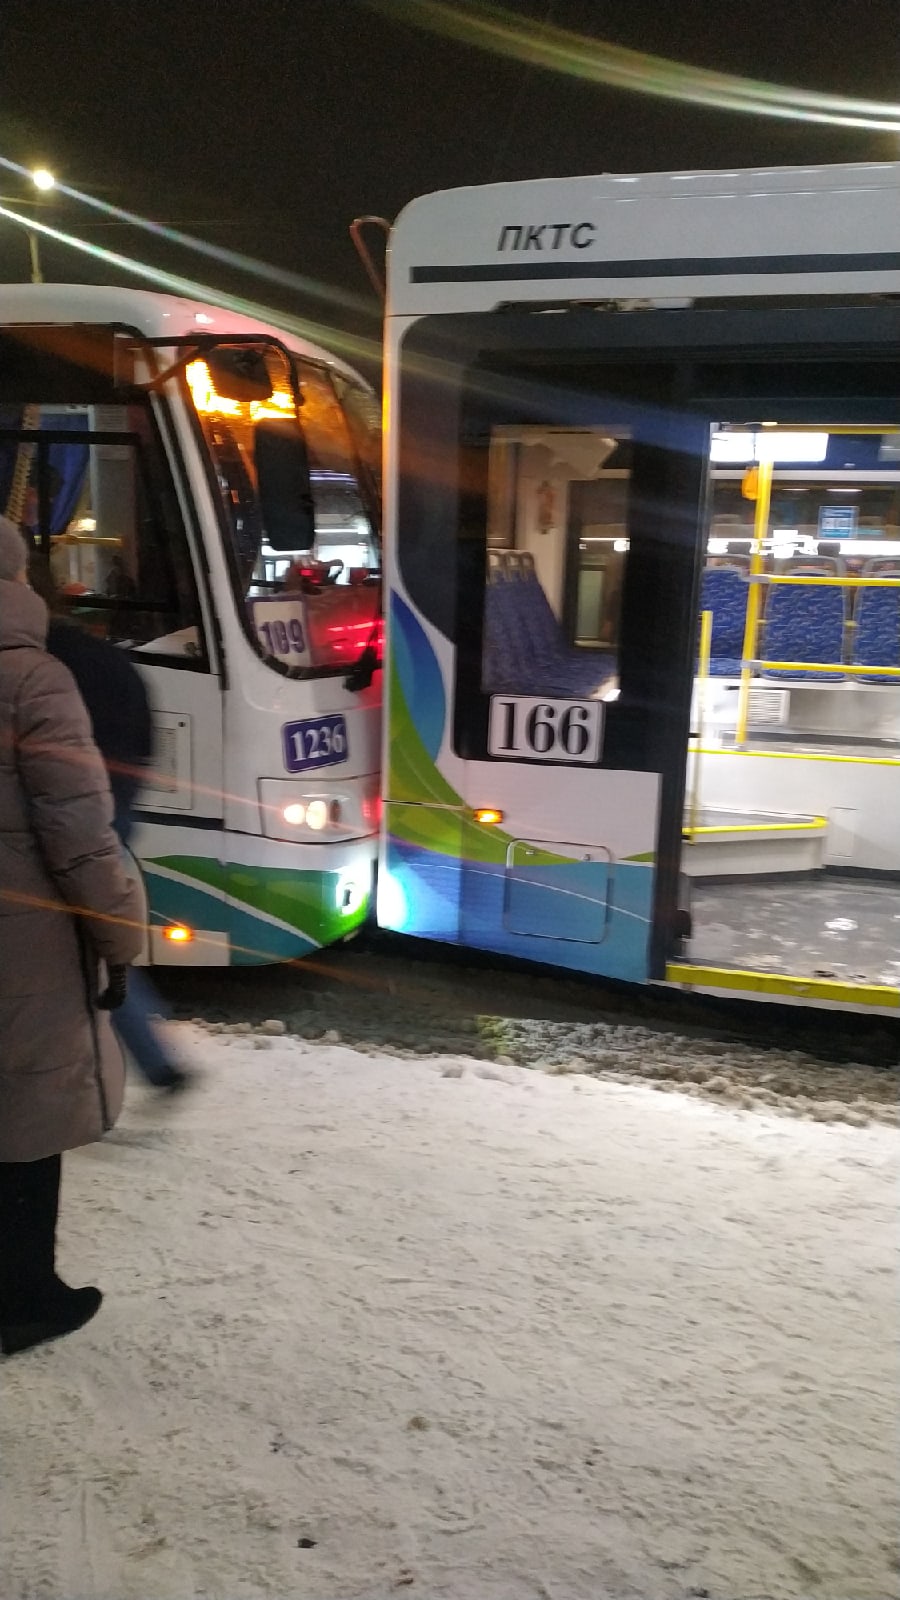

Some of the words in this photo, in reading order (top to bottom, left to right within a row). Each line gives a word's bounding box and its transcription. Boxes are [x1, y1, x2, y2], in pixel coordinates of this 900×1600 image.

[497, 222, 598, 251] ПКТС
[290, 723, 346, 762] 1236
[498, 702, 589, 755] 166
